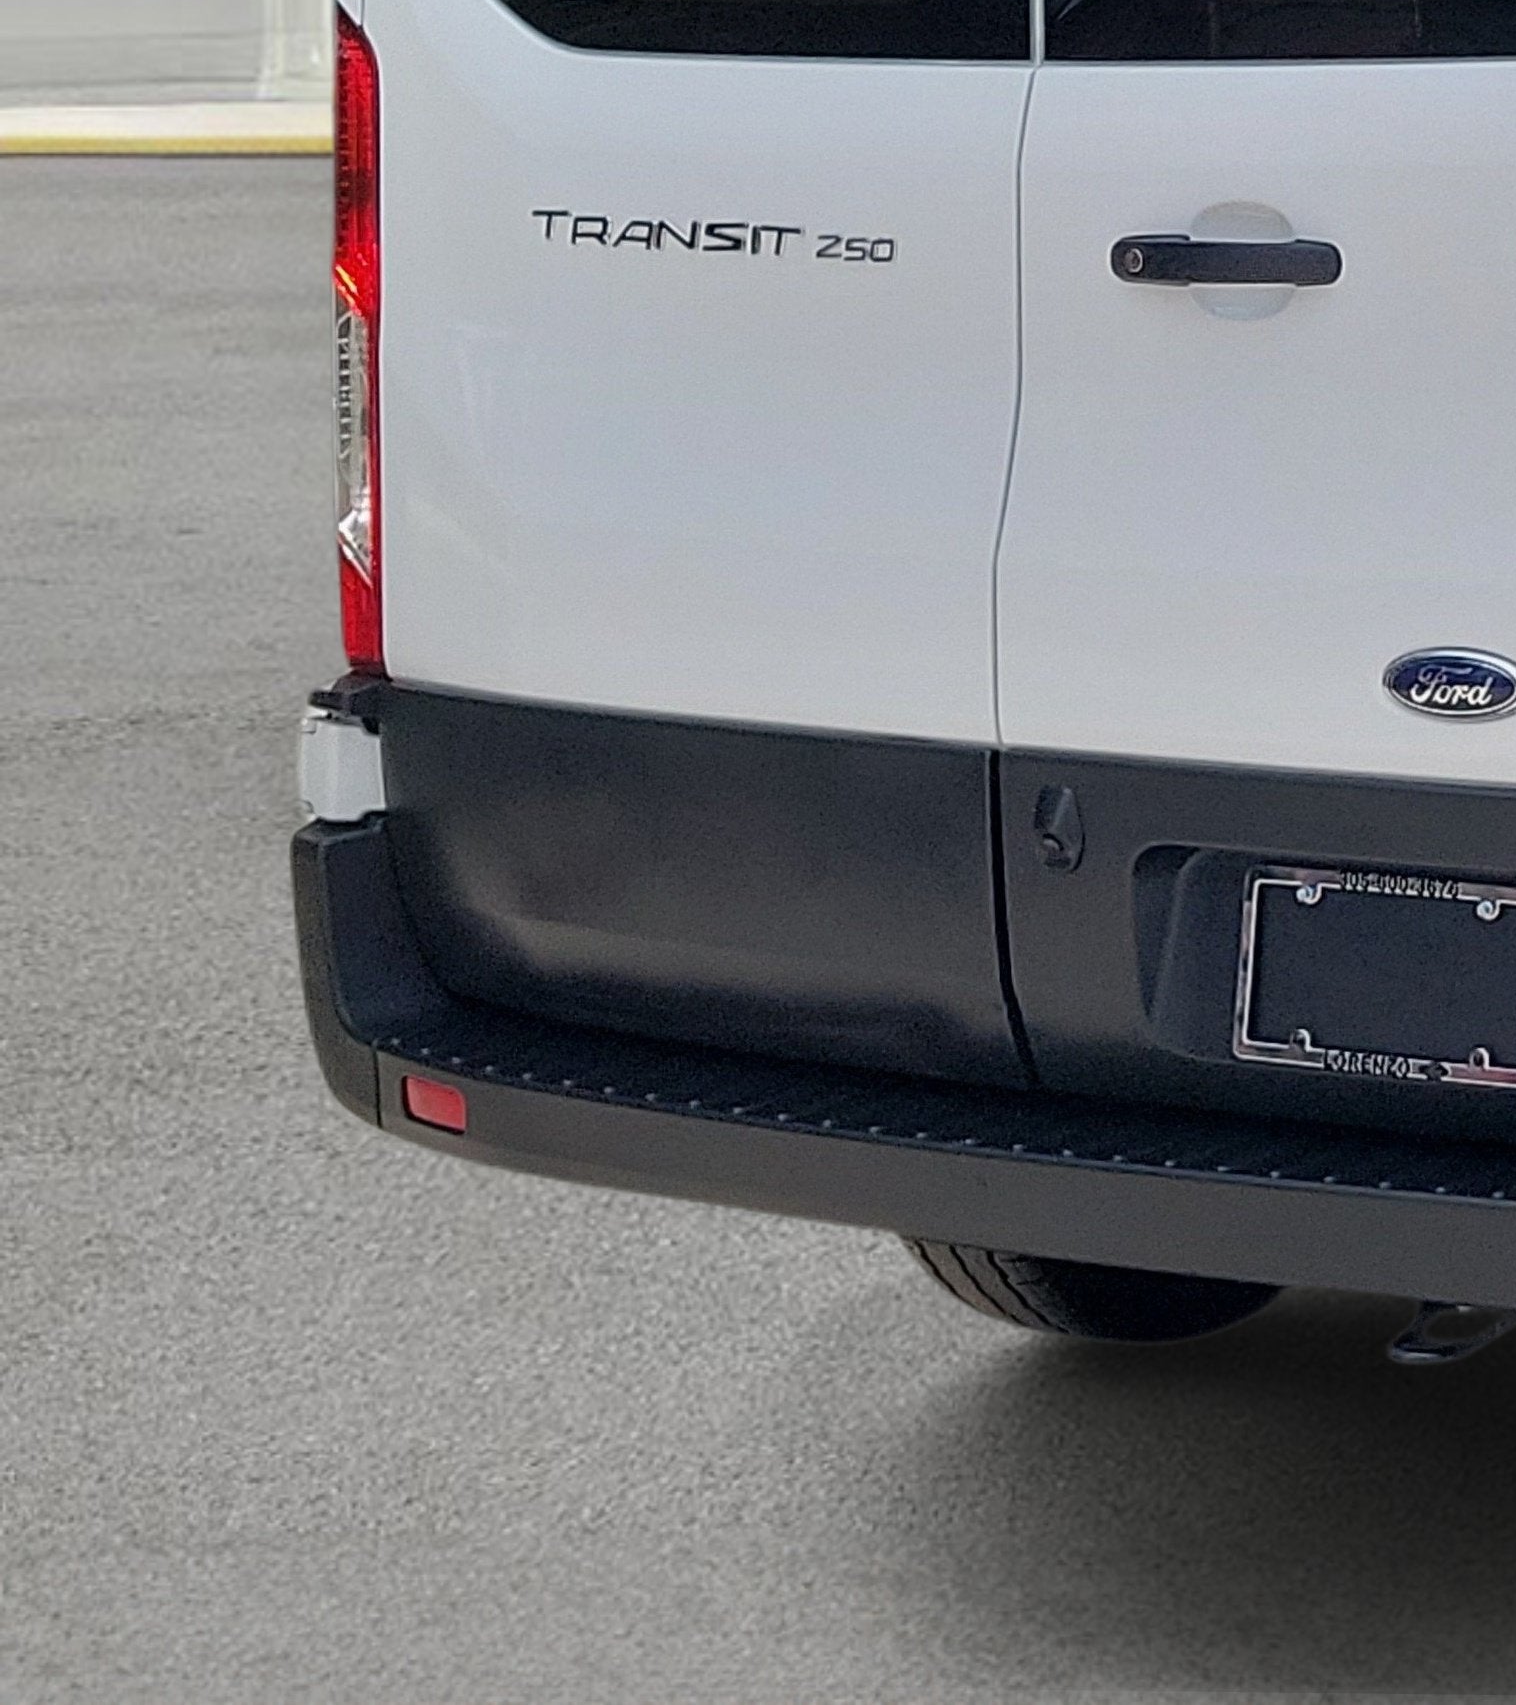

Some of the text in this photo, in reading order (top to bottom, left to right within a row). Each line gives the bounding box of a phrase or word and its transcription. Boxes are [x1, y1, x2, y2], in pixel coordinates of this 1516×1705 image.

[531, 209, 896, 263] TRANSIT 250
[1409, 664, 1494, 706] Ford
